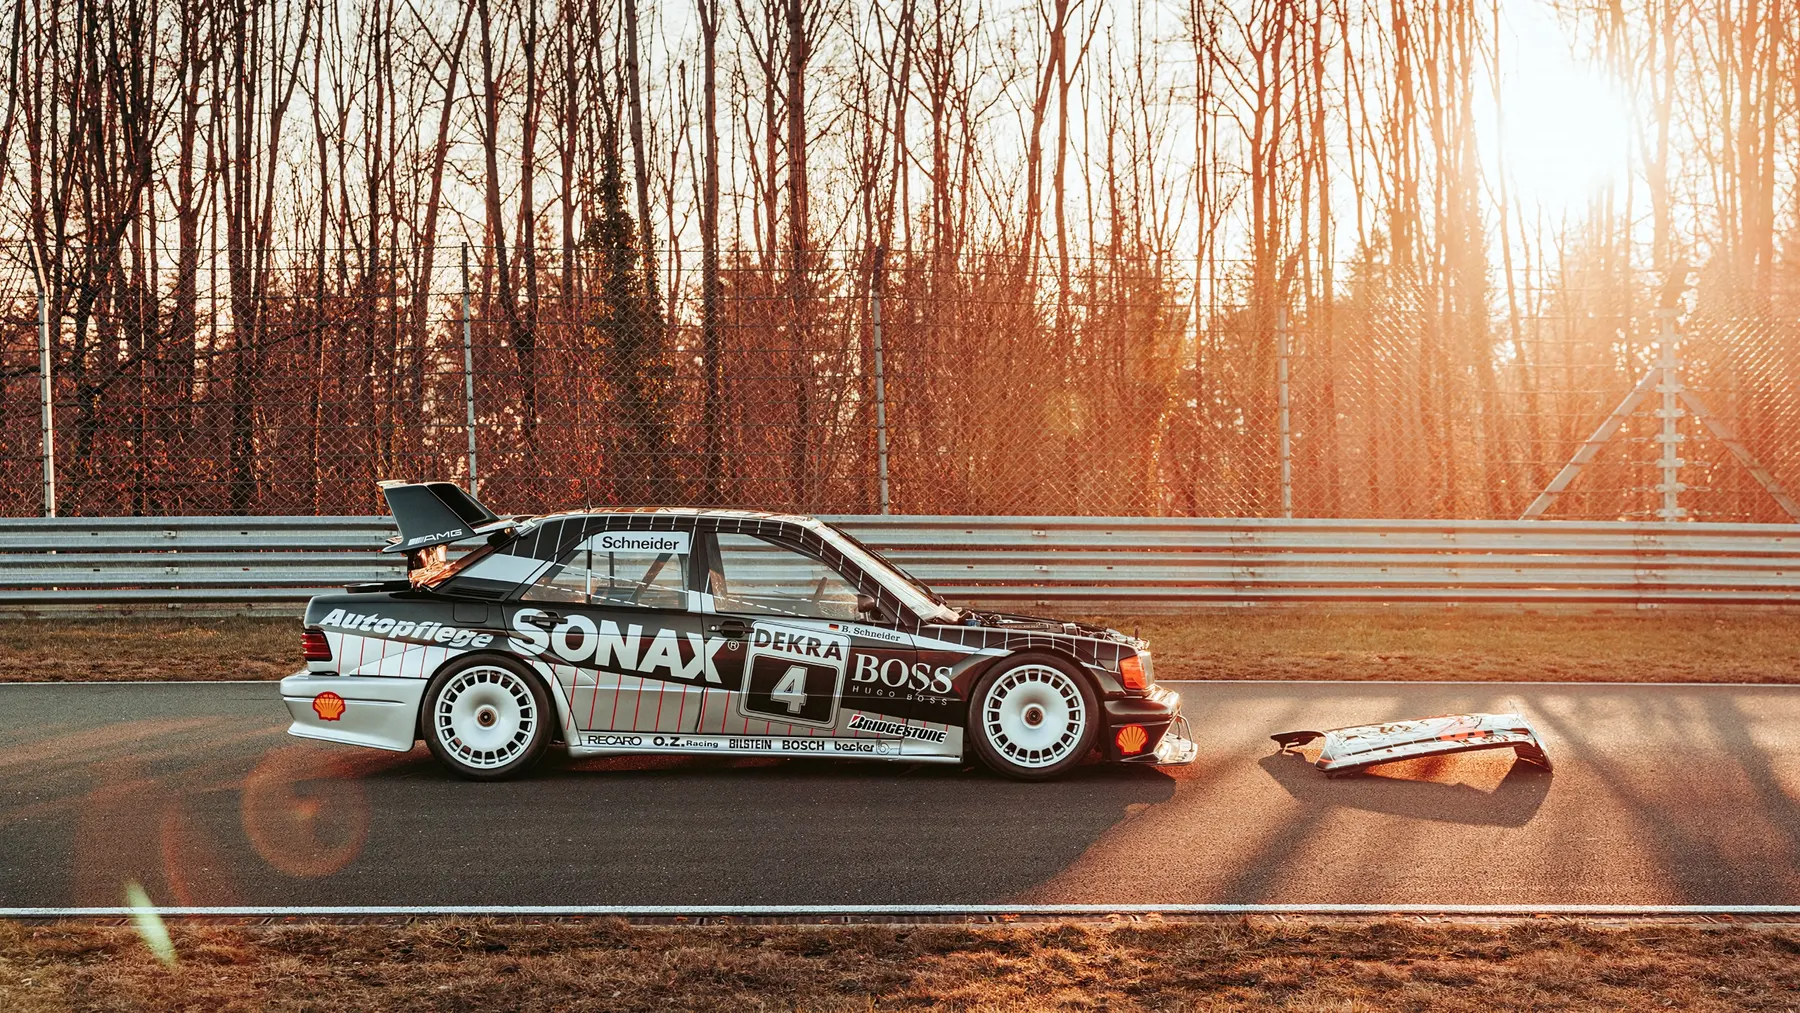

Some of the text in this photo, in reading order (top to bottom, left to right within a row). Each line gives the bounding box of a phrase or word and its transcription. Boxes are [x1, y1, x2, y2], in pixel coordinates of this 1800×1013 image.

[423, 529, 463, 543] AMG
[602, 536, 680, 550] Schneider
[319, 608, 494, 648] Autopflege
[842, 625, 901, 642] B. Schneider
[753, 628, 843, 661] DEKRA
[851, 653, 953, 694] BOSS
[771, 664, 808, 714] 4
[852, 685, 948, 706] HUGO BOSS
[848, 715, 947, 743] BRIDGESTONE
[587, 735, 643, 746] RECARO
[686, 740, 718, 748] Racing
[728, 738, 773, 750] BILSTEIN
[782, 740, 825, 751] BOSCH
[834, 741, 875, 753] becker
